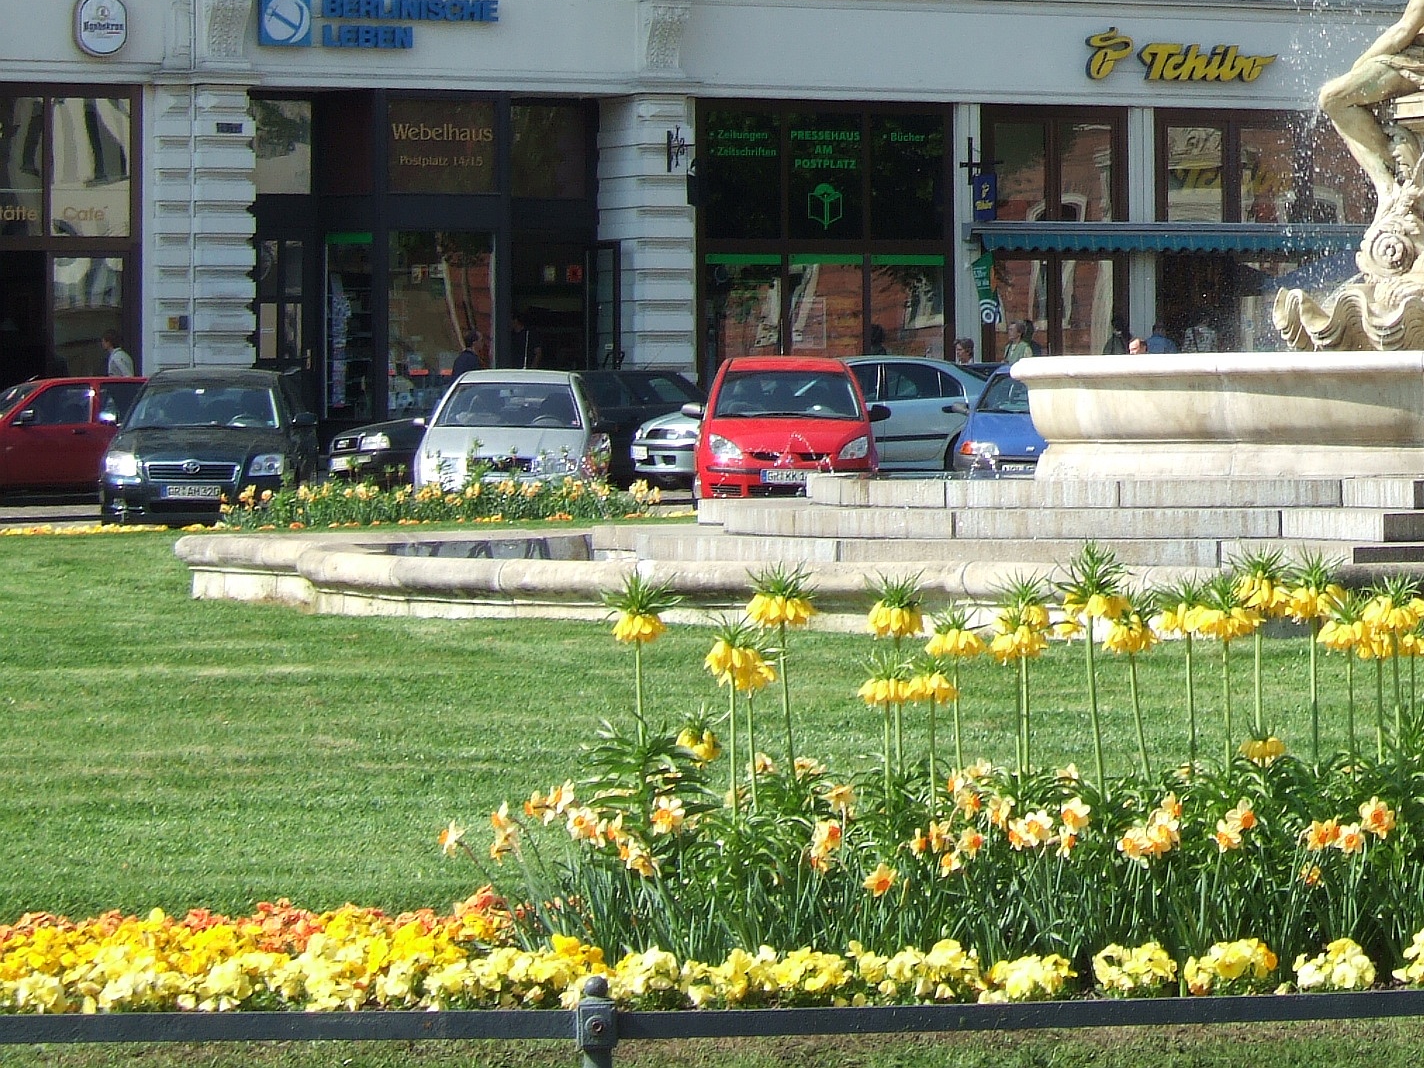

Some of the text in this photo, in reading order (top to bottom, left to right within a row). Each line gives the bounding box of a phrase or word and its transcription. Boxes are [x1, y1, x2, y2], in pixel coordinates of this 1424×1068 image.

[322, 24, 413, 48] LEBEN
[1137, 44, 1278, 82] Tchibo
[392, 123, 493, 141] Webelhaus
[718, 130, 768, 142] Zeitungen
[790, 131, 860, 142] PRESSEHAUS
[890, 131, 925, 143] Bücher
[717, 146, 777, 157] Zeitschriften
[814, 144, 833, 155] AM
[400, 155, 483, 167] Postplatz 14/15
[794, 159, 857, 170] POSTPLATZ
